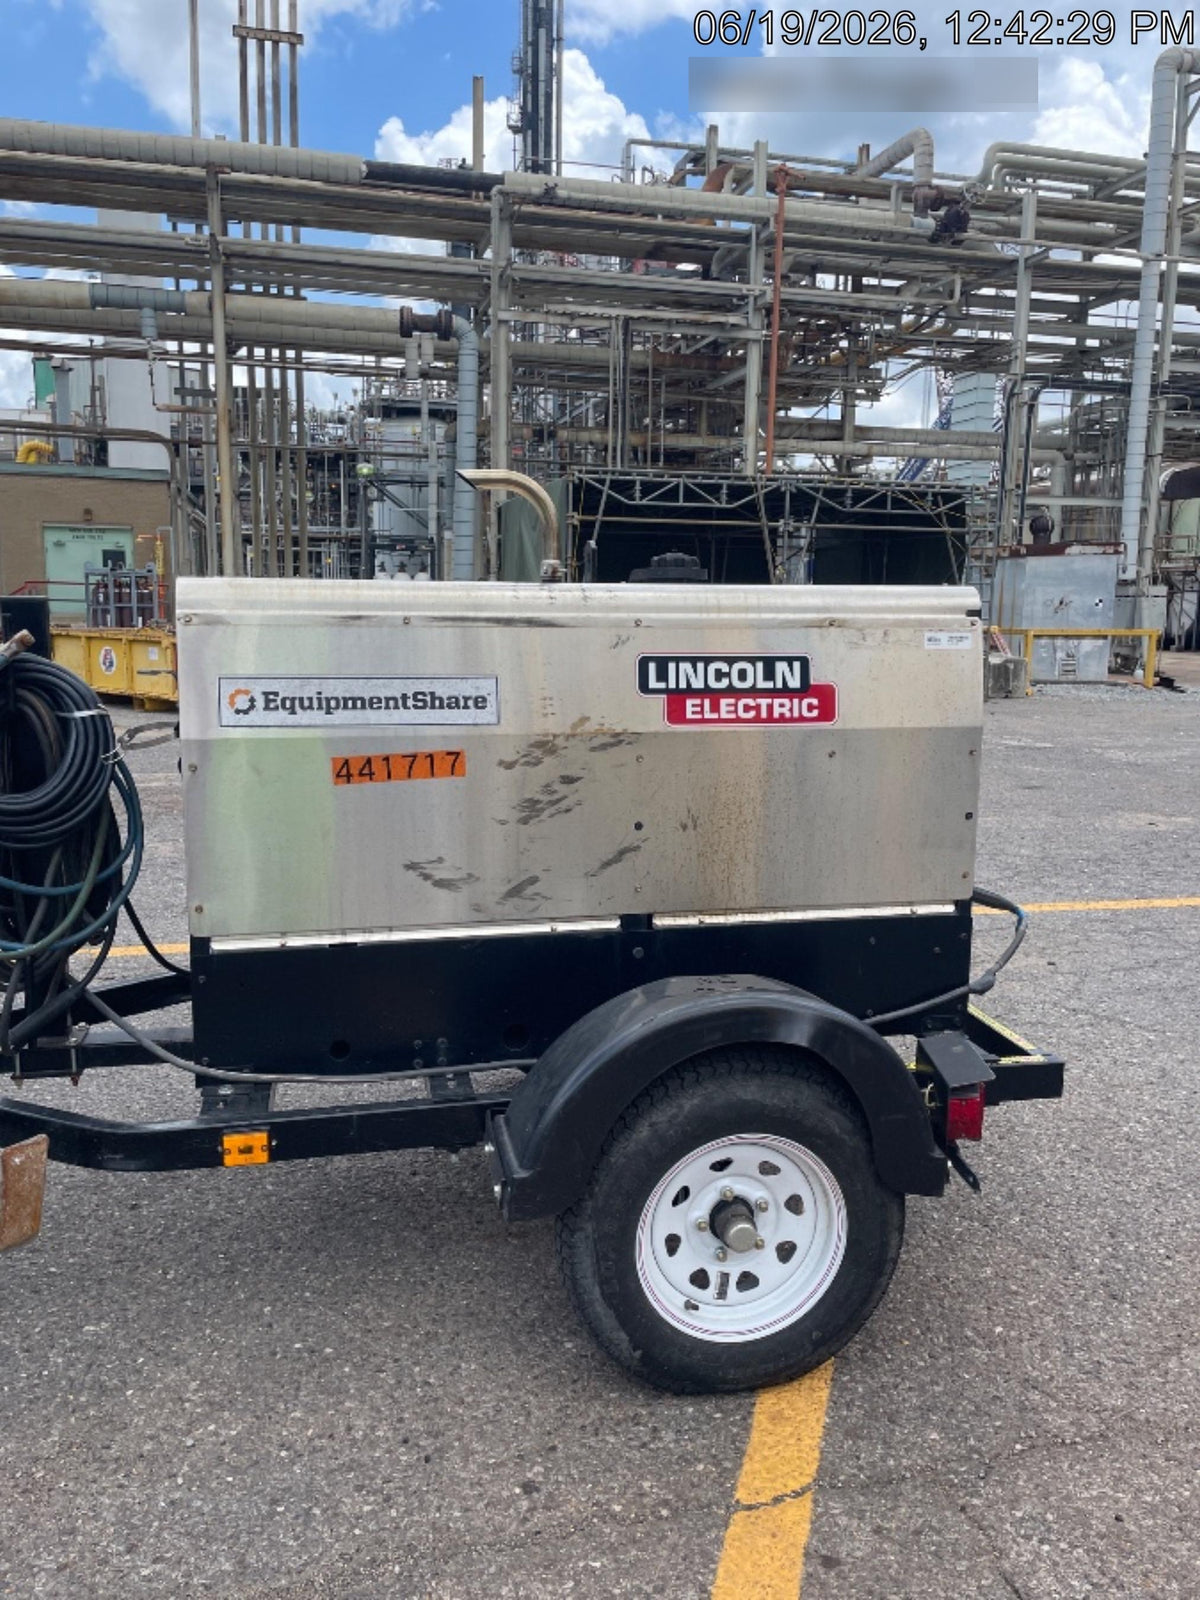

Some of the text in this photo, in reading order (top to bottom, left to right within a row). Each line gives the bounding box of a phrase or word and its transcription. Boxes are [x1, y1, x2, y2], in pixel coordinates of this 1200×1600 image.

[648, 660, 801, 689] LINCOLN
[261, 691, 488, 715] EquipmentShare
[685, 698, 819, 719] ELECTRIC
[335, 751, 461, 784] 441717
